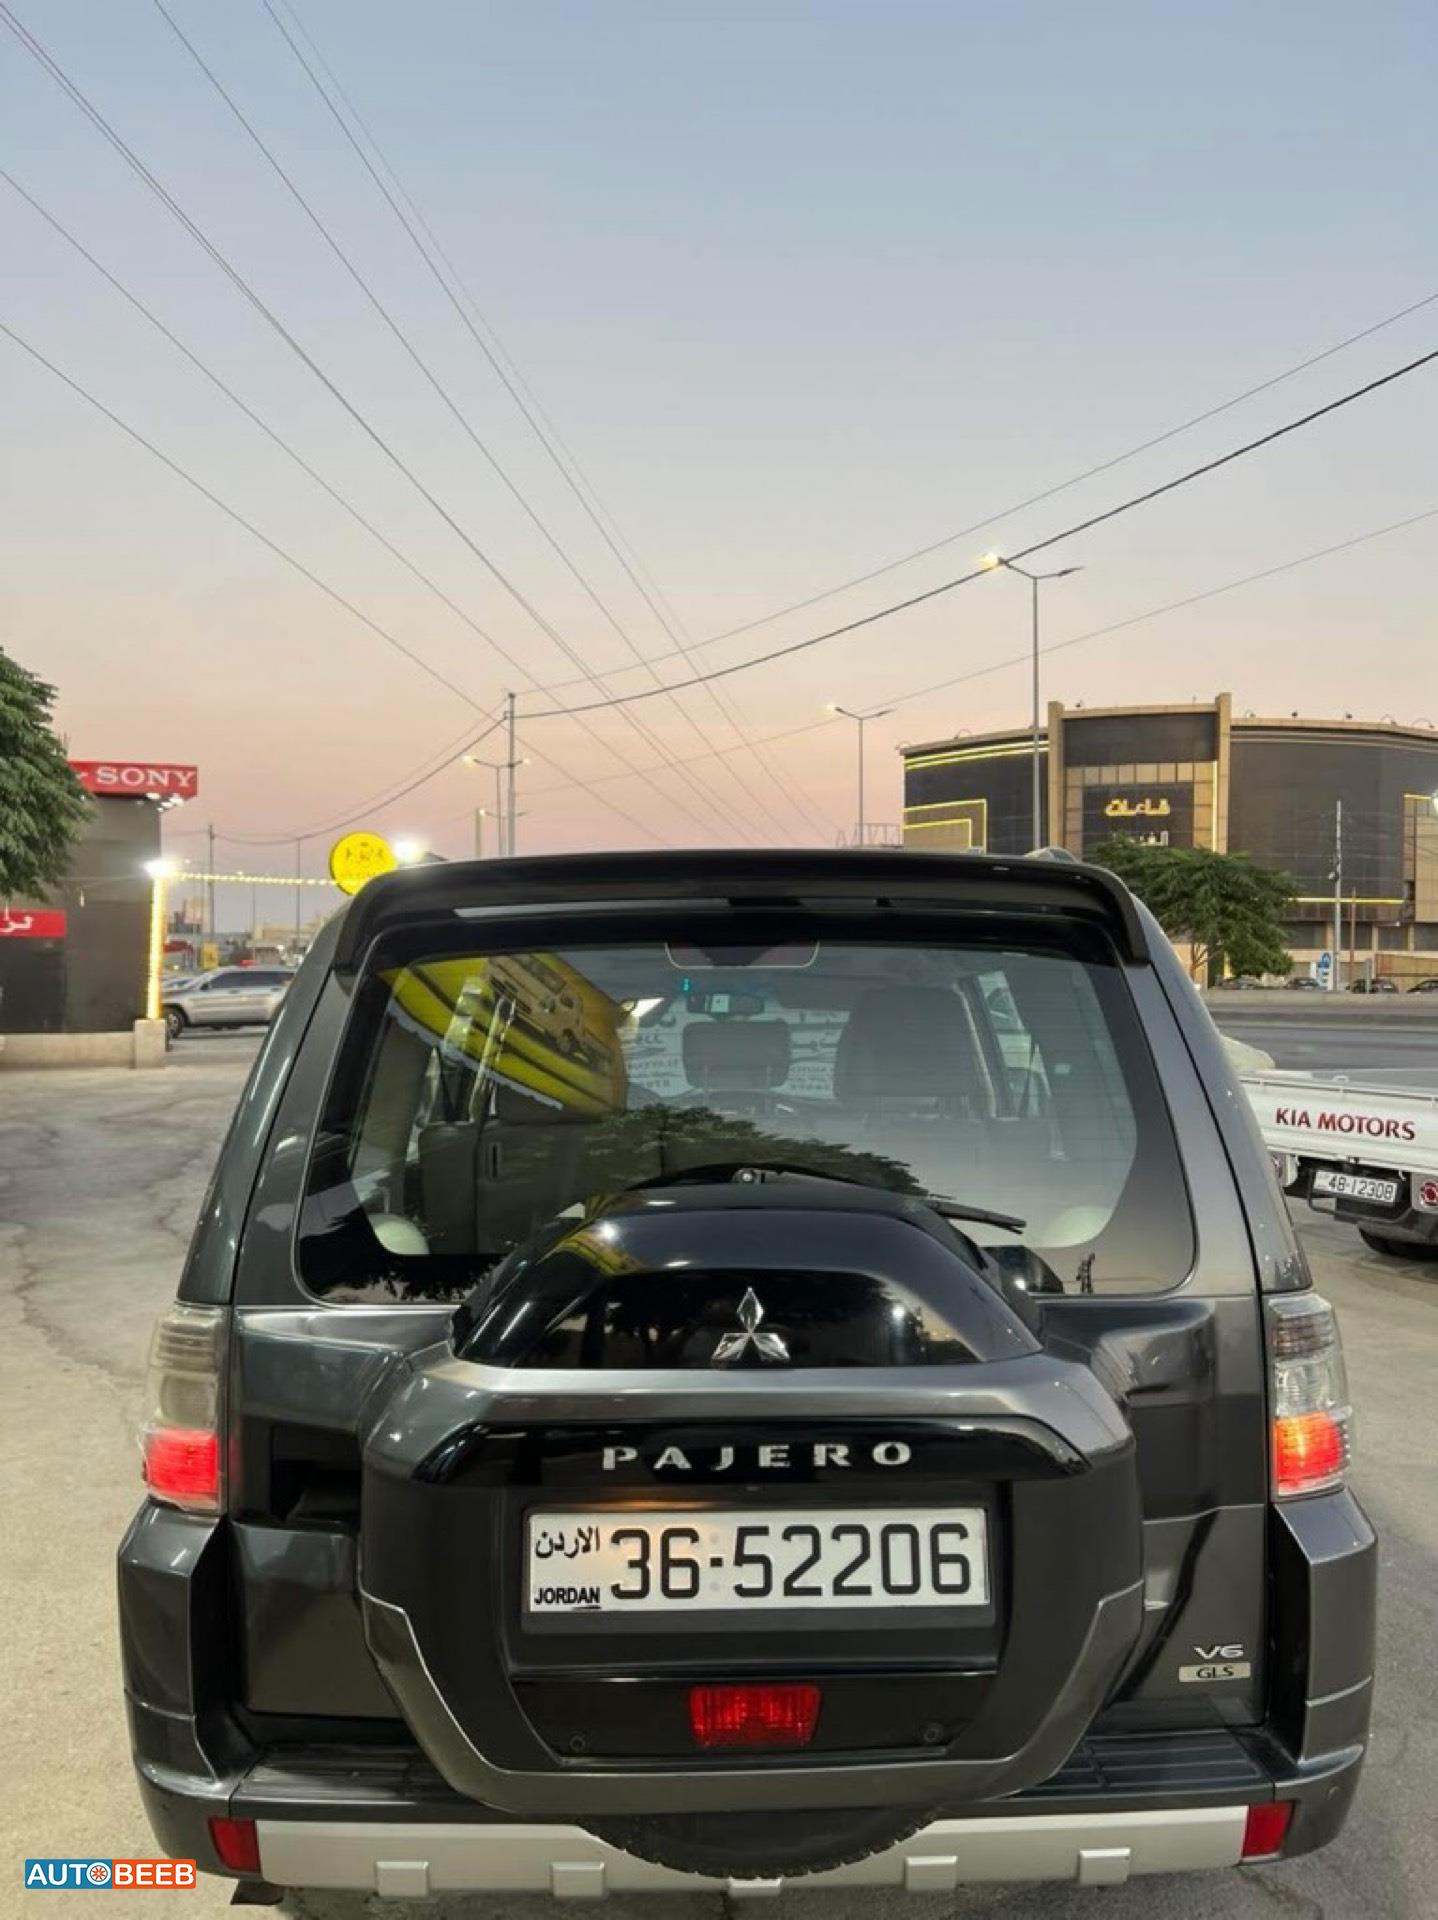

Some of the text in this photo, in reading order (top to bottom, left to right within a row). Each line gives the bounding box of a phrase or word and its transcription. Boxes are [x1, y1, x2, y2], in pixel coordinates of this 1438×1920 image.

[97, 766, 195, 786] SONY
[1276, 1108, 1415, 1140] KIA MOTORS
[602, 1441, 912, 1471] PAJERO
[535, 1526, 600, 1558] الاردن
[610, 1523, 971, 1600] 36-52206
[534, 1586, 600, 1604] JORDAN
[1194, 1643, 1244, 1659] V6
[1196, 1665, 1234, 1678] GLS
